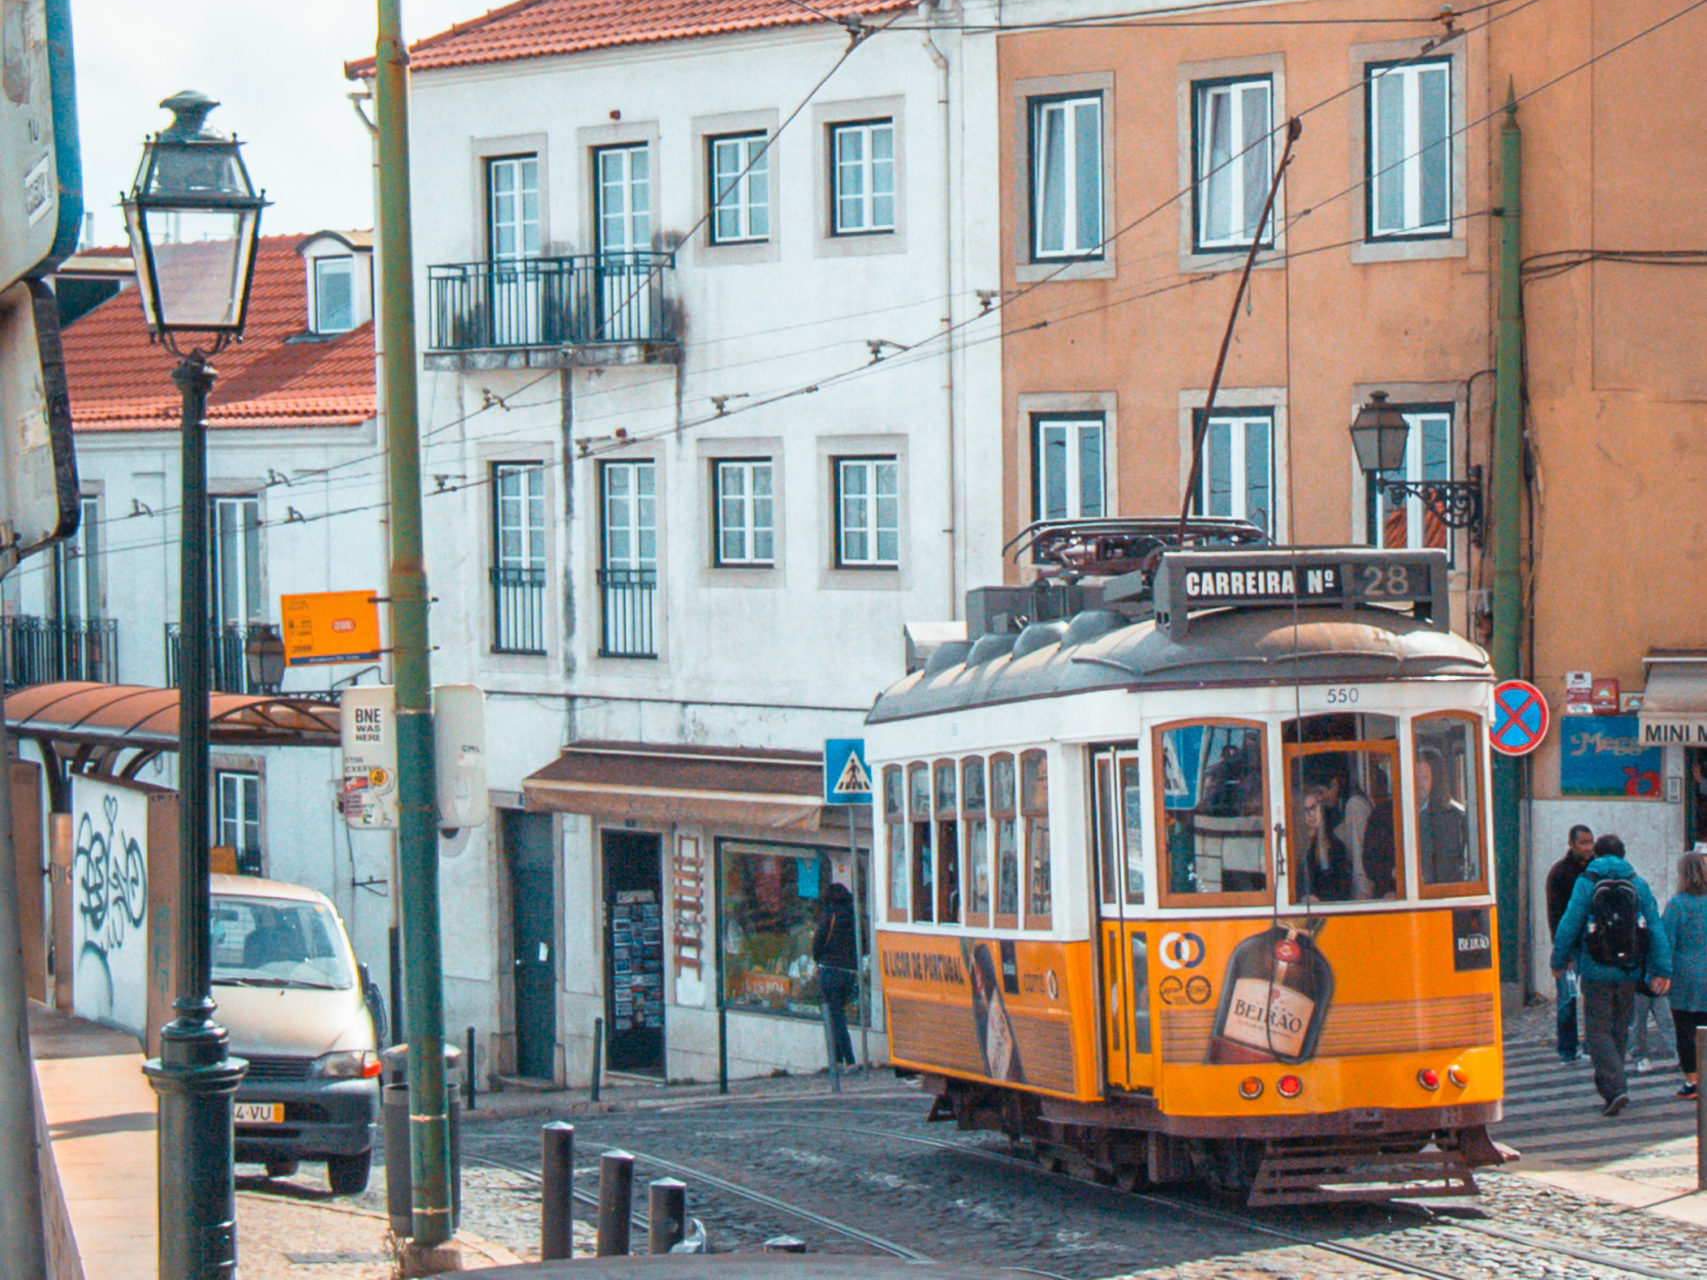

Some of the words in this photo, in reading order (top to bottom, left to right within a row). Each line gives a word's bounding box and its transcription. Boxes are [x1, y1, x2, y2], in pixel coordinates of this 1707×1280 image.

[1186, 570, 1295, 596] CARREIRA
[1363, 565, 1409, 596] 28
[1326, 687, 1359, 704] 550
[355, 708, 381, 724] BNE
[356, 724, 381, 732] WAS
[1645, 724, 1690, 741] MINI
[1235, 999, 1303, 1034] BEIRÃO
